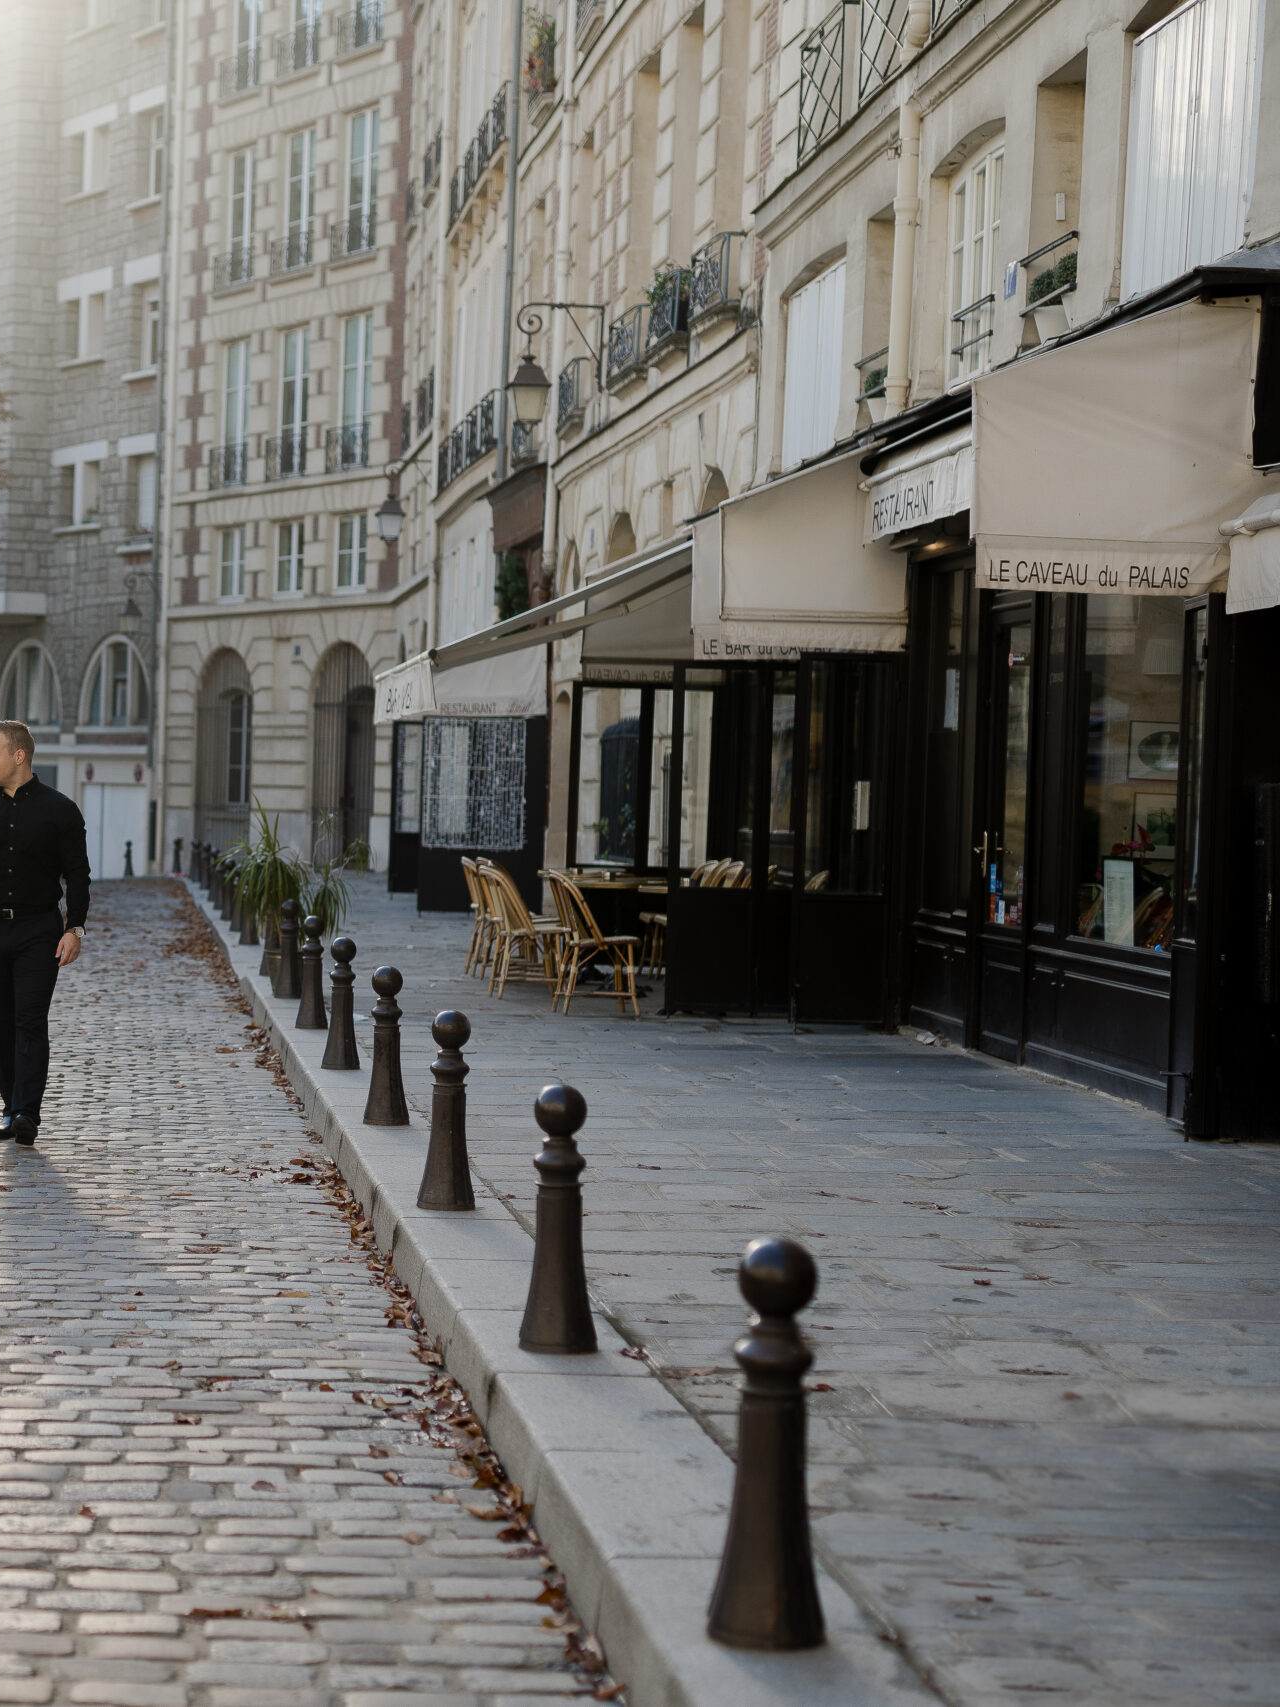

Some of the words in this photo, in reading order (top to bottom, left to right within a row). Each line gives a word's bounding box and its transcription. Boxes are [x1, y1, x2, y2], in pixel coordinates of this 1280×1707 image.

[989, 559, 1010, 582] LE
[1016, 560, 1088, 586] CAVEAU
[1098, 565, 1118, 587] du
[1129, 565, 1190, 589] PALAIS
[702, 639, 718, 655] LE
[440, 702, 496, 714] RESTAURANT
